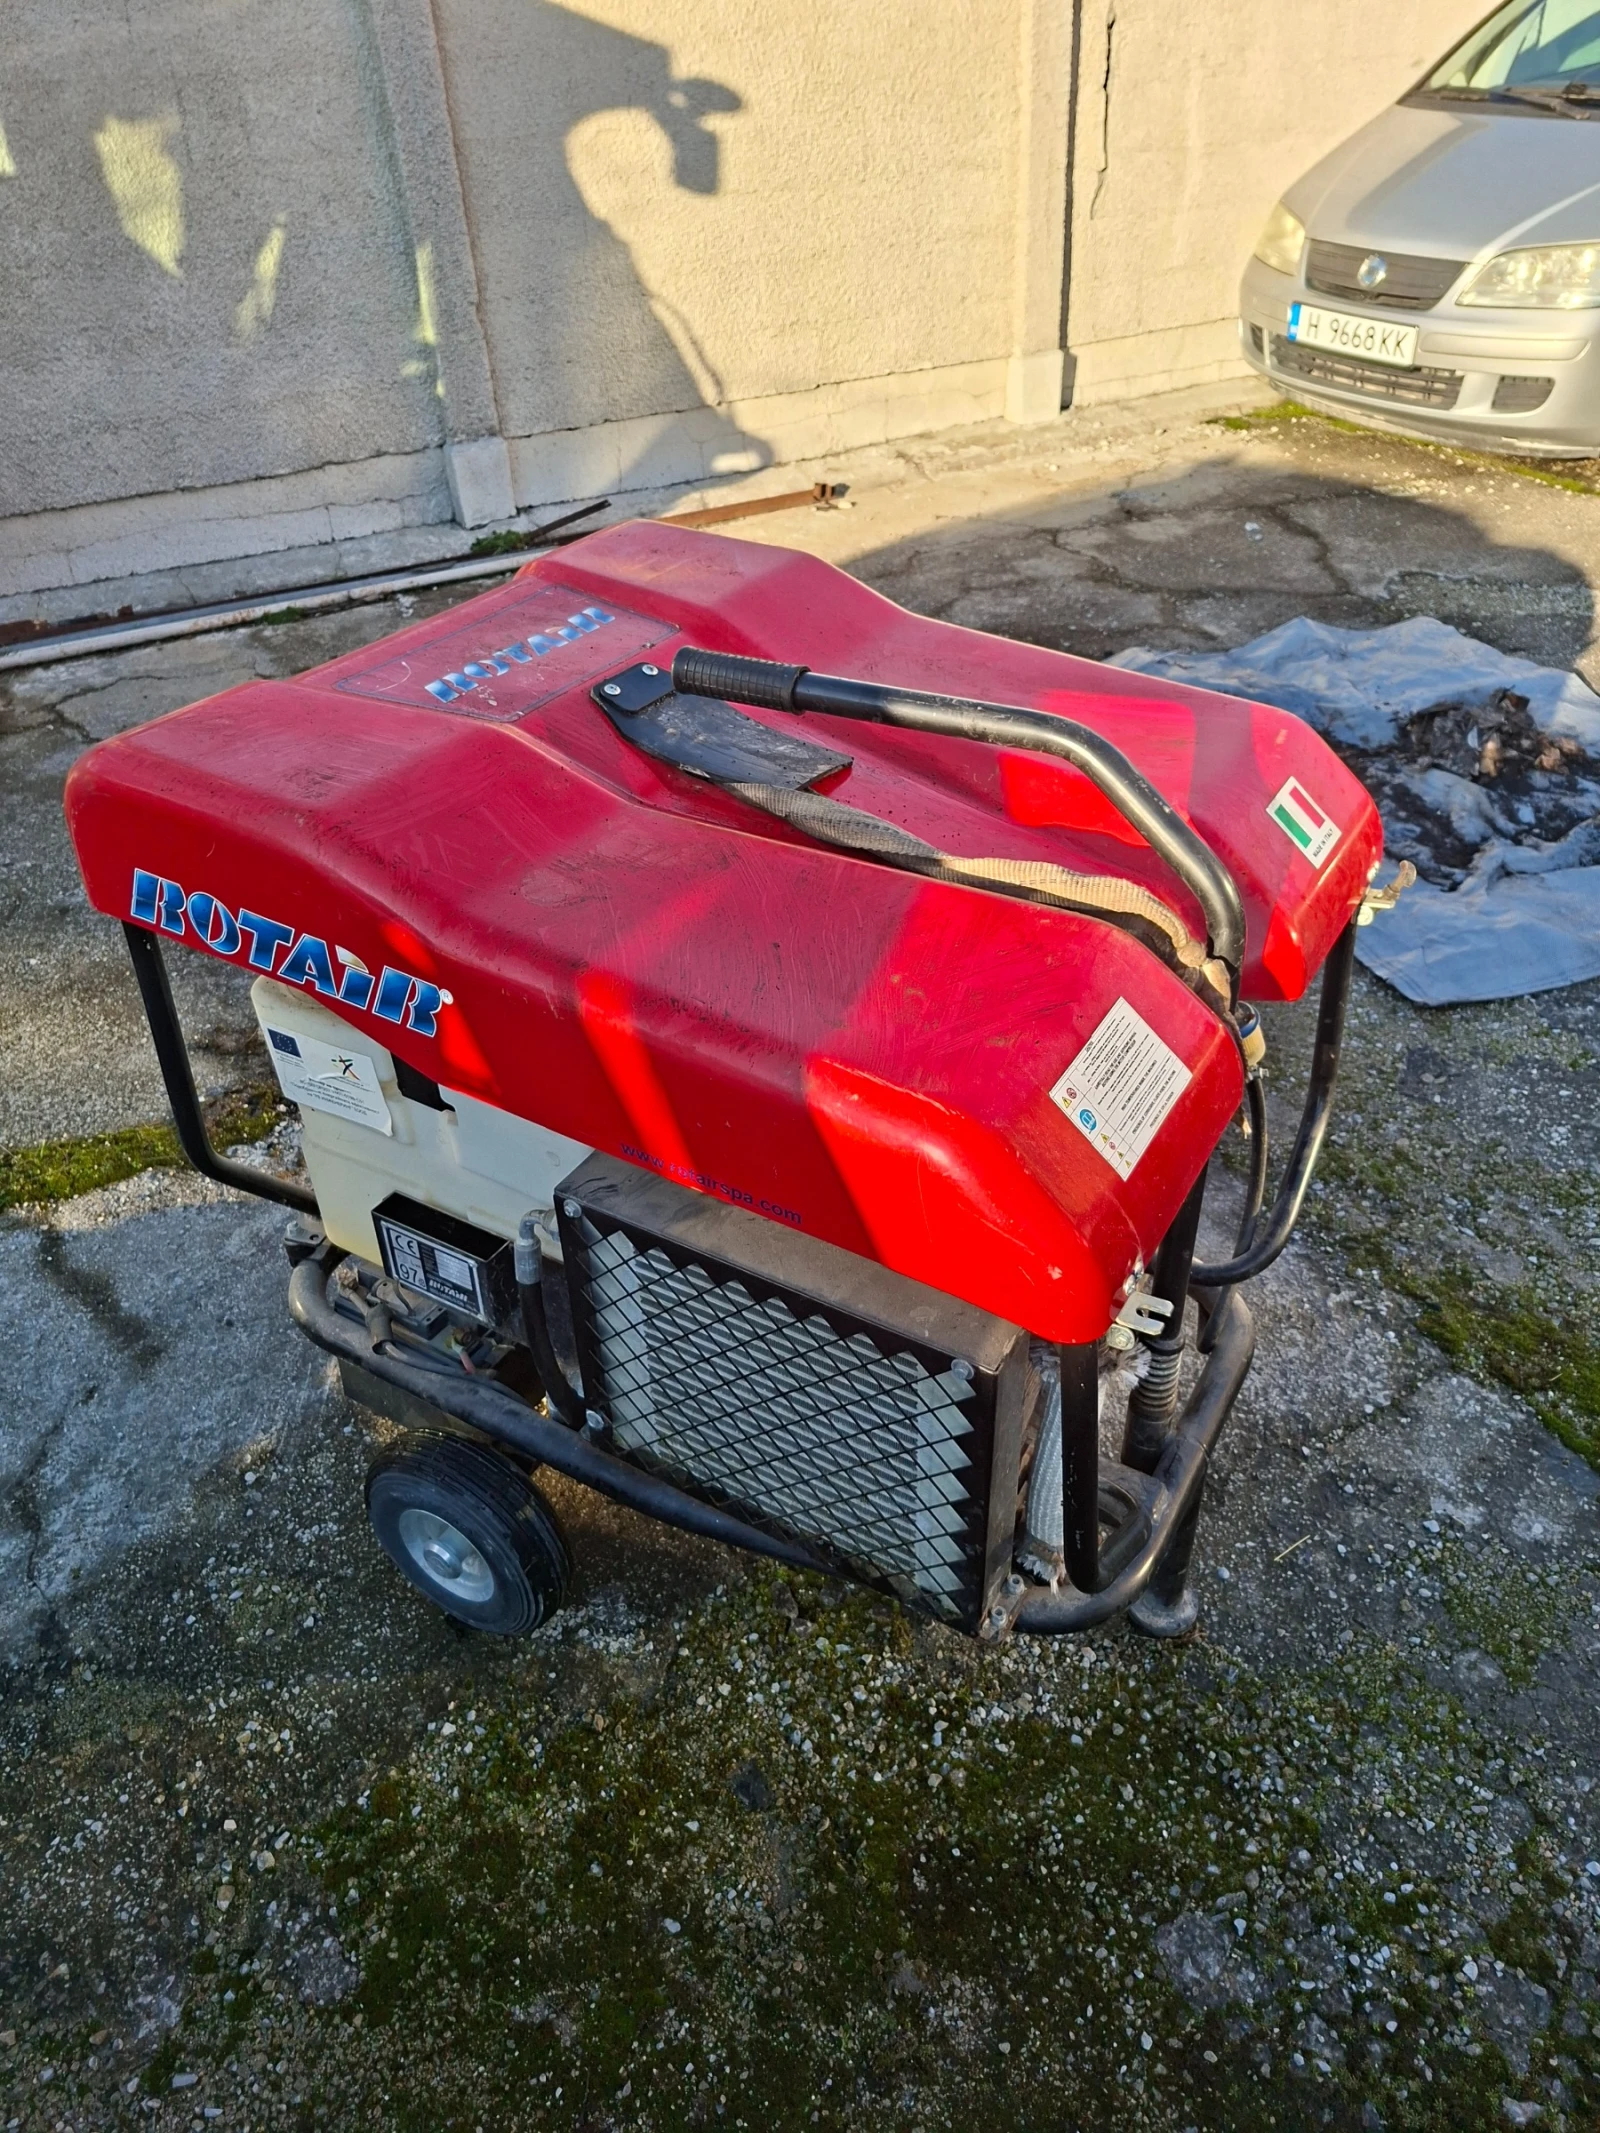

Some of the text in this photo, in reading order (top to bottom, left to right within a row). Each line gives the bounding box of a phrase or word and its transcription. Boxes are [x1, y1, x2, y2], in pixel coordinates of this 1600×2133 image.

[1307, 312, 1321, 339] H
[424, 607, 615, 703] ROTAIR
[1312, 845, 1323, 857] MADE
[1325, 828, 1334, 842] ITALY
[131, 867, 443, 1037] ROTAIR
[620, 1143, 802, 1224] wwwrotairspa.com
[395, 1234, 416, 1255] CE
[399, 1263, 418, 1283] 97
